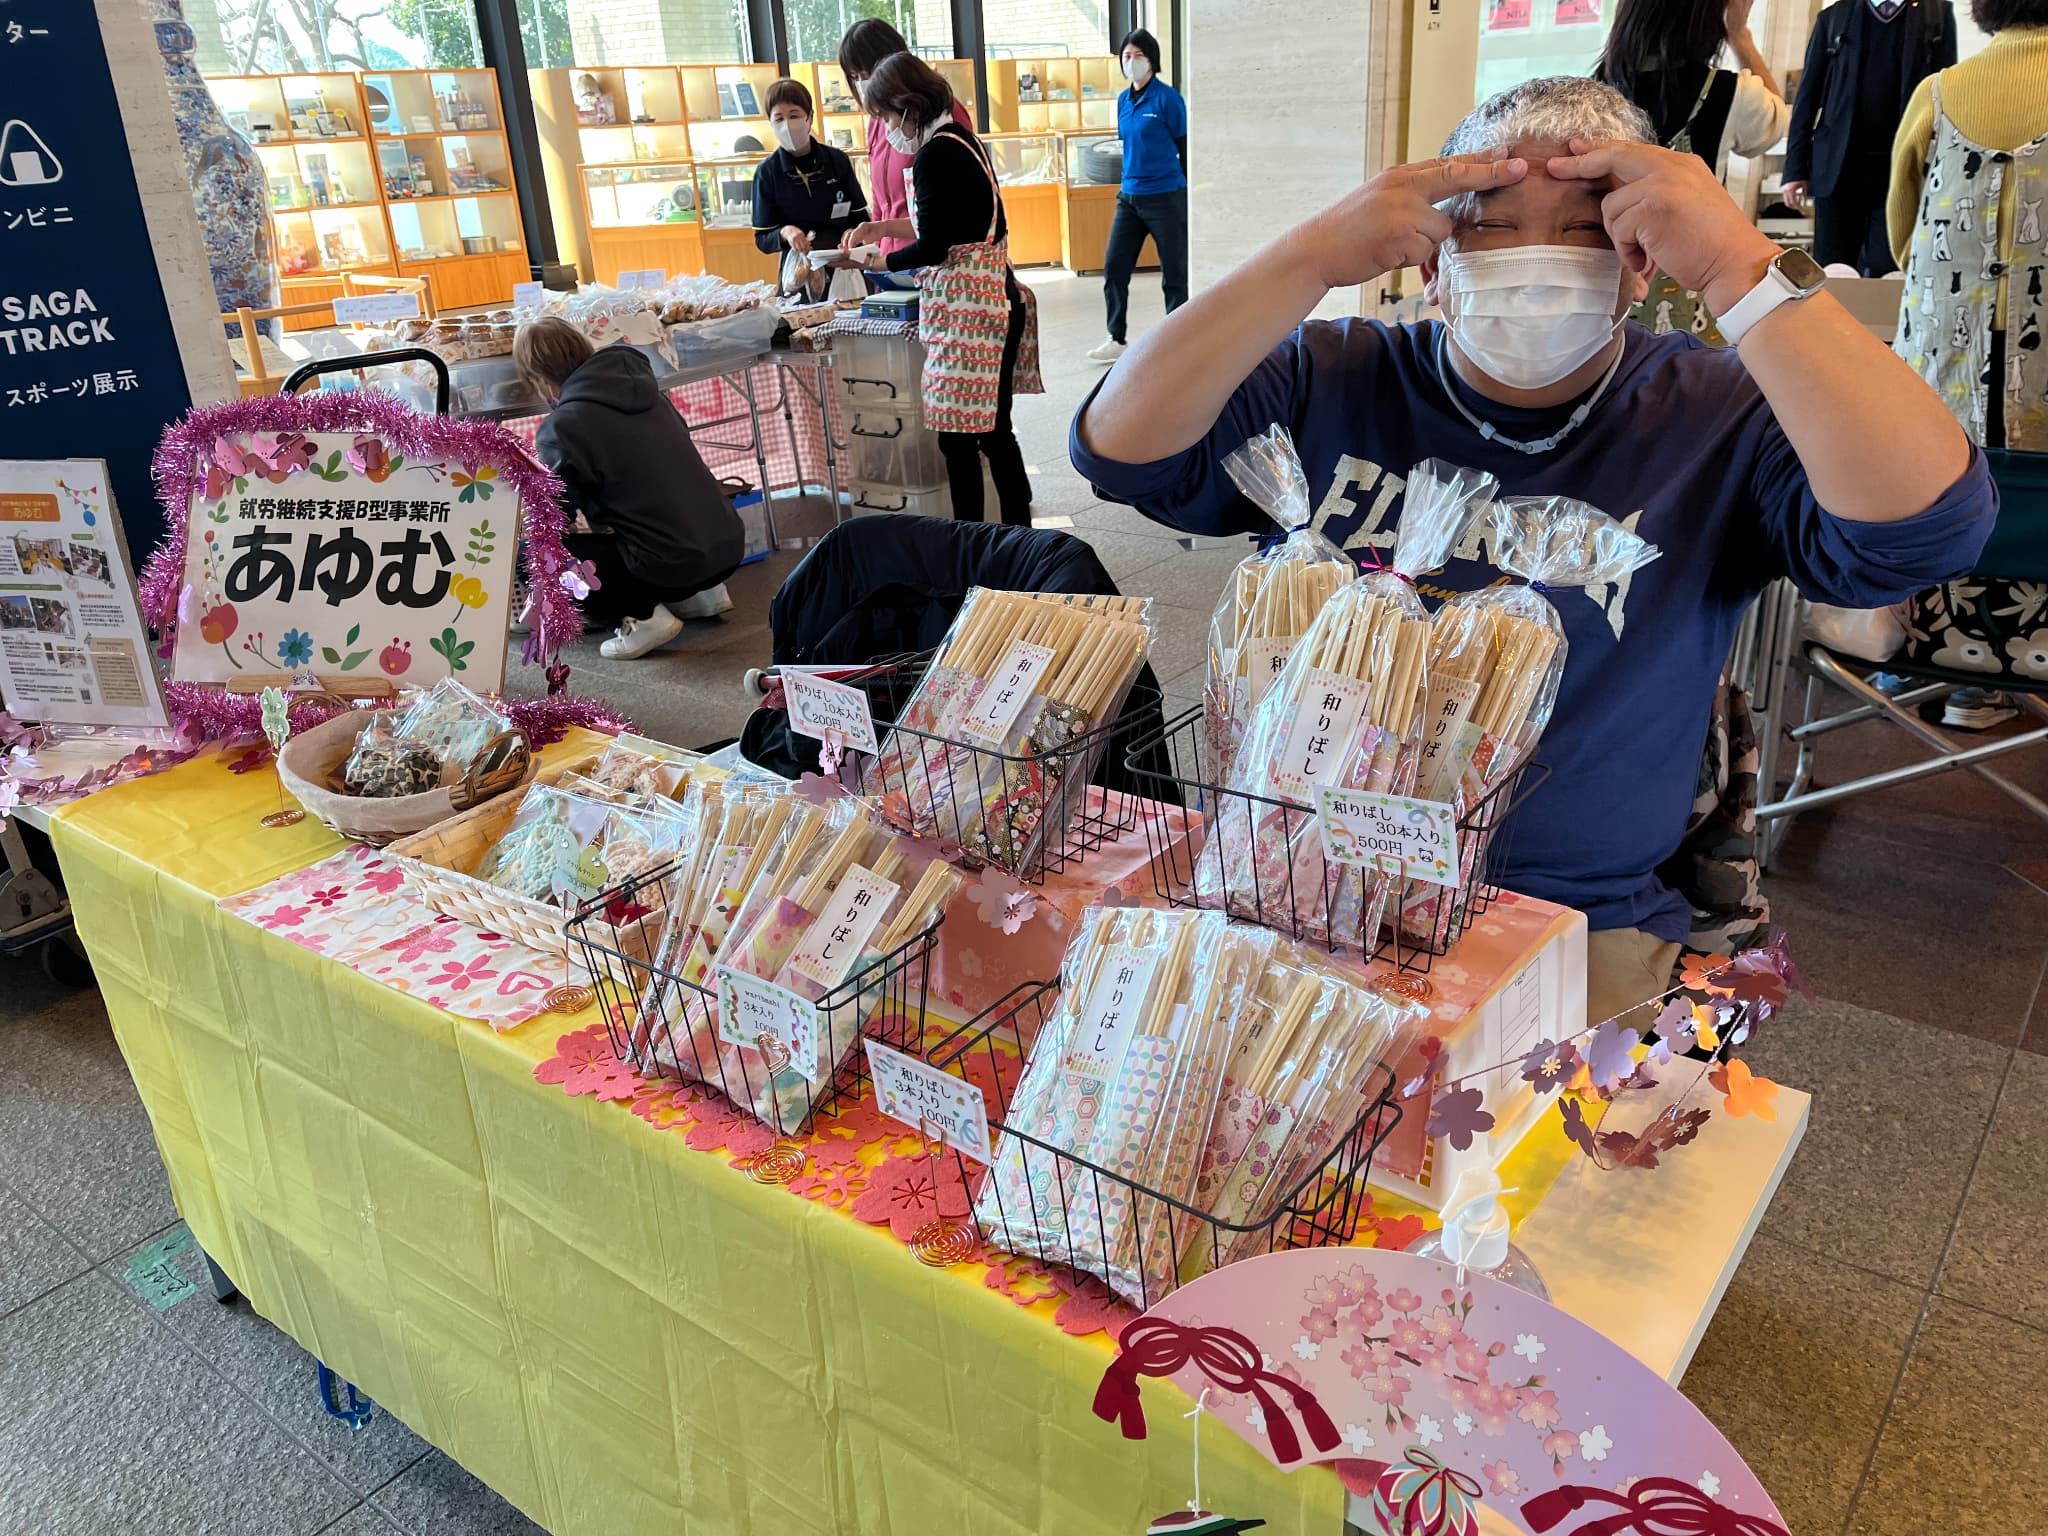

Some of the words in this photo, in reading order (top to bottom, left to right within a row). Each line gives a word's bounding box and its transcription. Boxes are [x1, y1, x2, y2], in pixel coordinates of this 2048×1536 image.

[6, 20, 49, 43] ター
[3, 206, 74, 230] ンビニ
[1, 288, 97, 322] SAGA
[0, 317, 116, 355] TRACK
[5, 369, 139, 407] スポーツ展示
[239, 498, 451, 523] 就労継続支援B型事業所
[224, 525, 456, 609] あゆむ
[794, 681, 832, 703] 和りばし
[989, 658, 1033, 719] 和りばし
[812, 713, 842, 729] 200円
[1303, 693, 1342, 776] 和りばし
[1332, 800, 1392, 821] 和りばし
[1358, 835, 1402, 855] 500円
[1376, 821, 1441, 845] 30本入り
[822, 889, 872, 960] 和りばし
[743, 1001, 774, 1020] 3本入り
[1093, 966, 1134, 1053] 和りばし
[754, 1020, 779, 1039] 100円
[895, 1079, 940, 1109] 3本入り
[900, 1067, 952, 1100] 和りばし
[919, 1105, 956, 1133] 100円
